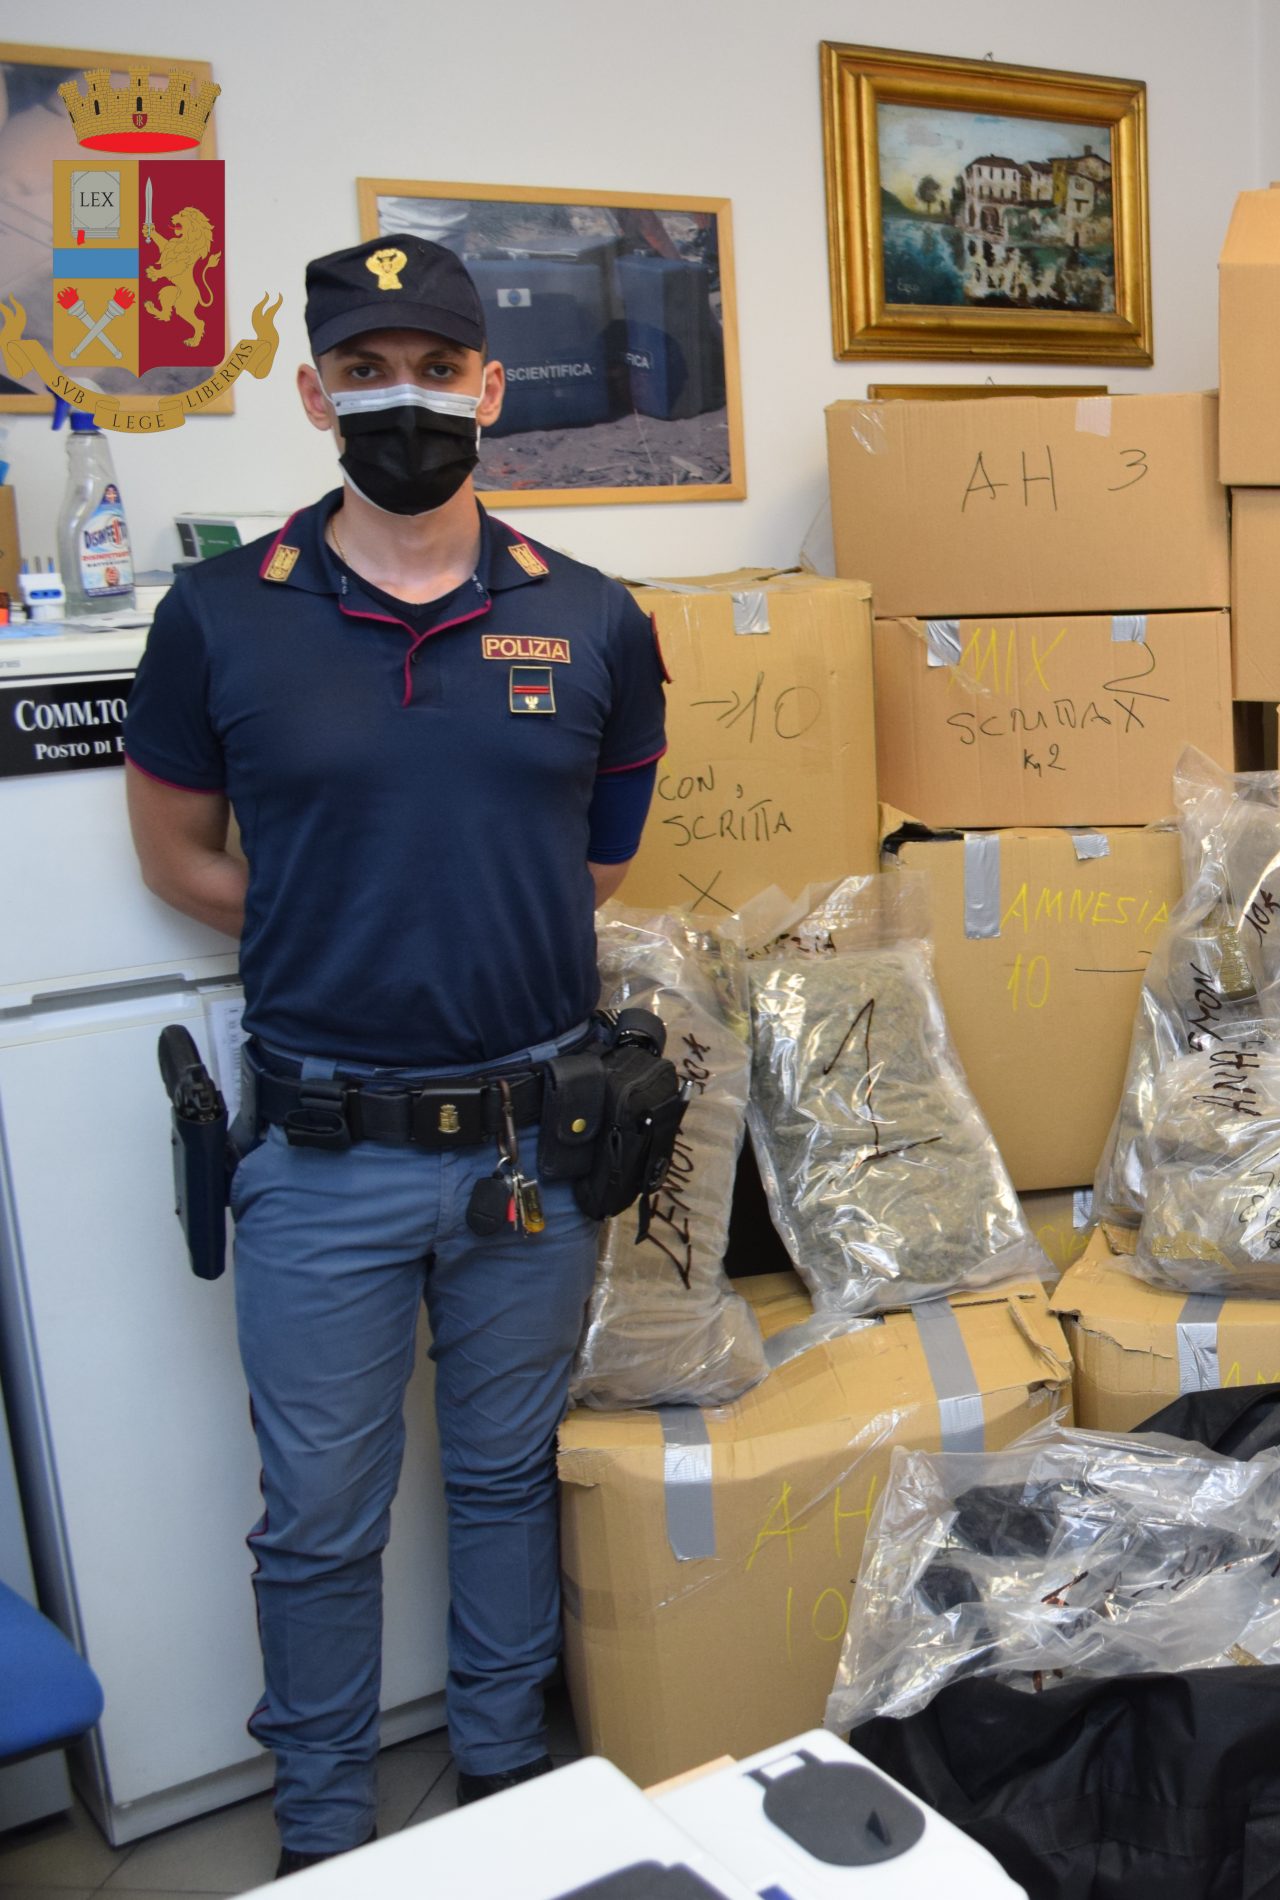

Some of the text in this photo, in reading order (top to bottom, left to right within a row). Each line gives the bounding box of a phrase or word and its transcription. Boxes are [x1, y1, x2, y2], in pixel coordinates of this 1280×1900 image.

[505, 362, 593, 382] SCIENTIFICA
[960, 445, 1149, 513] AH 3
[485, 637, 568, 660] POLIZIA
[946, 627, 1068, 695] MIX
[1046, 742, 1067, 772] 2
[1006, 952, 1050, 1013] 10
[786, 1586, 849, 1664] 10
